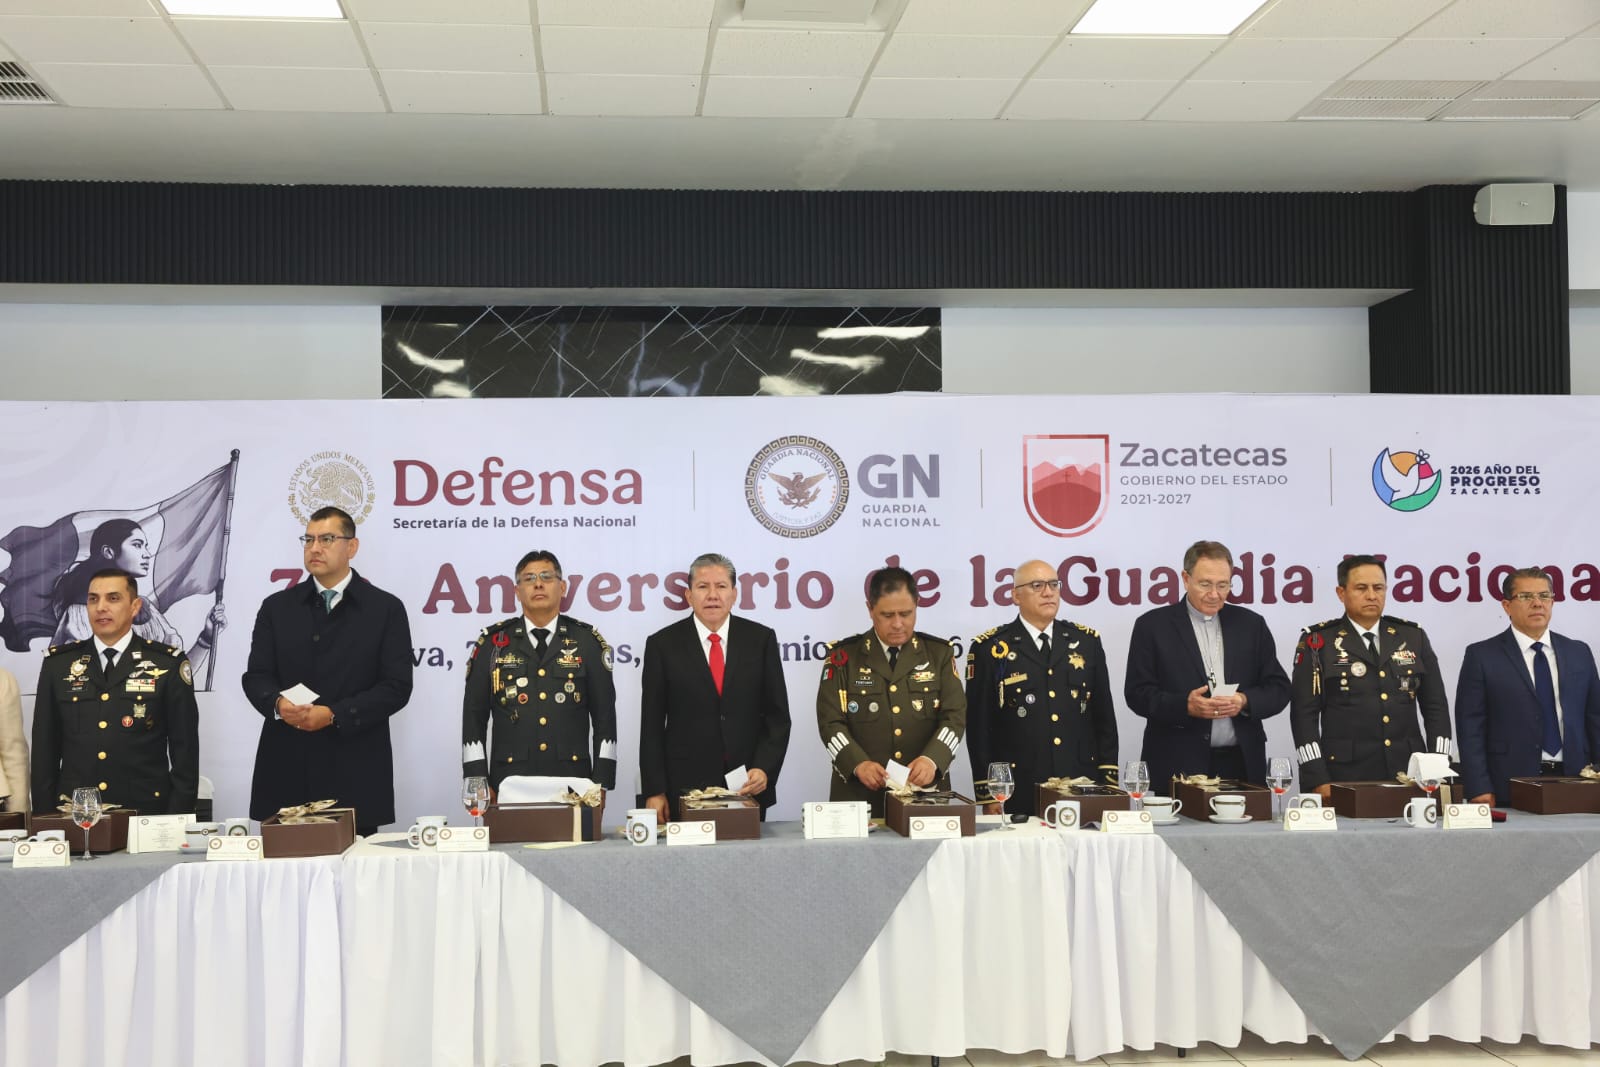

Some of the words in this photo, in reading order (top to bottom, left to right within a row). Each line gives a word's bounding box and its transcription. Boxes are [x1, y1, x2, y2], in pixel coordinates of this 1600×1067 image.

[1120, 442, 1288, 468] Zacatecas
[288, 459, 310, 491] ESTADOS
[311, 451, 341, 463] UNIDOS
[343, 453, 375, 491] MEXICANOS
[760, 449, 794, 480] GUARDIA
[796, 449, 835, 480] NACIONAL
[1450, 465, 1480, 476] 2026
[1484, 463, 1512, 475] AÑO
[1515, 464, 1541, 475] DEL
[393, 456, 643, 507] Defensa
[857, 453, 941, 500] GN
[1119, 475, 1196, 486] GOBIERNO
[1200, 475, 1228, 485] DEL
[1232, 475, 1289, 485] ESTADO
[1450, 476, 1541, 488] PROGRESO
[1450, 488, 1542, 496] ZACATECAS
[1120, 493, 1192, 505] 2021-2027
[862, 503, 927, 514] GUARDIA
[393, 516, 467, 529] Secretaría
[472, 516, 489, 529] de
[493, 516, 506, 528] la
[511, 516, 569, 528] Defensa
[573, 515, 637, 528] Nacional
[862, 517, 941, 528] NACIONAL
[422, 558, 834, 614] Anversrio
[1057, 551, 1314, 606] Guadia
